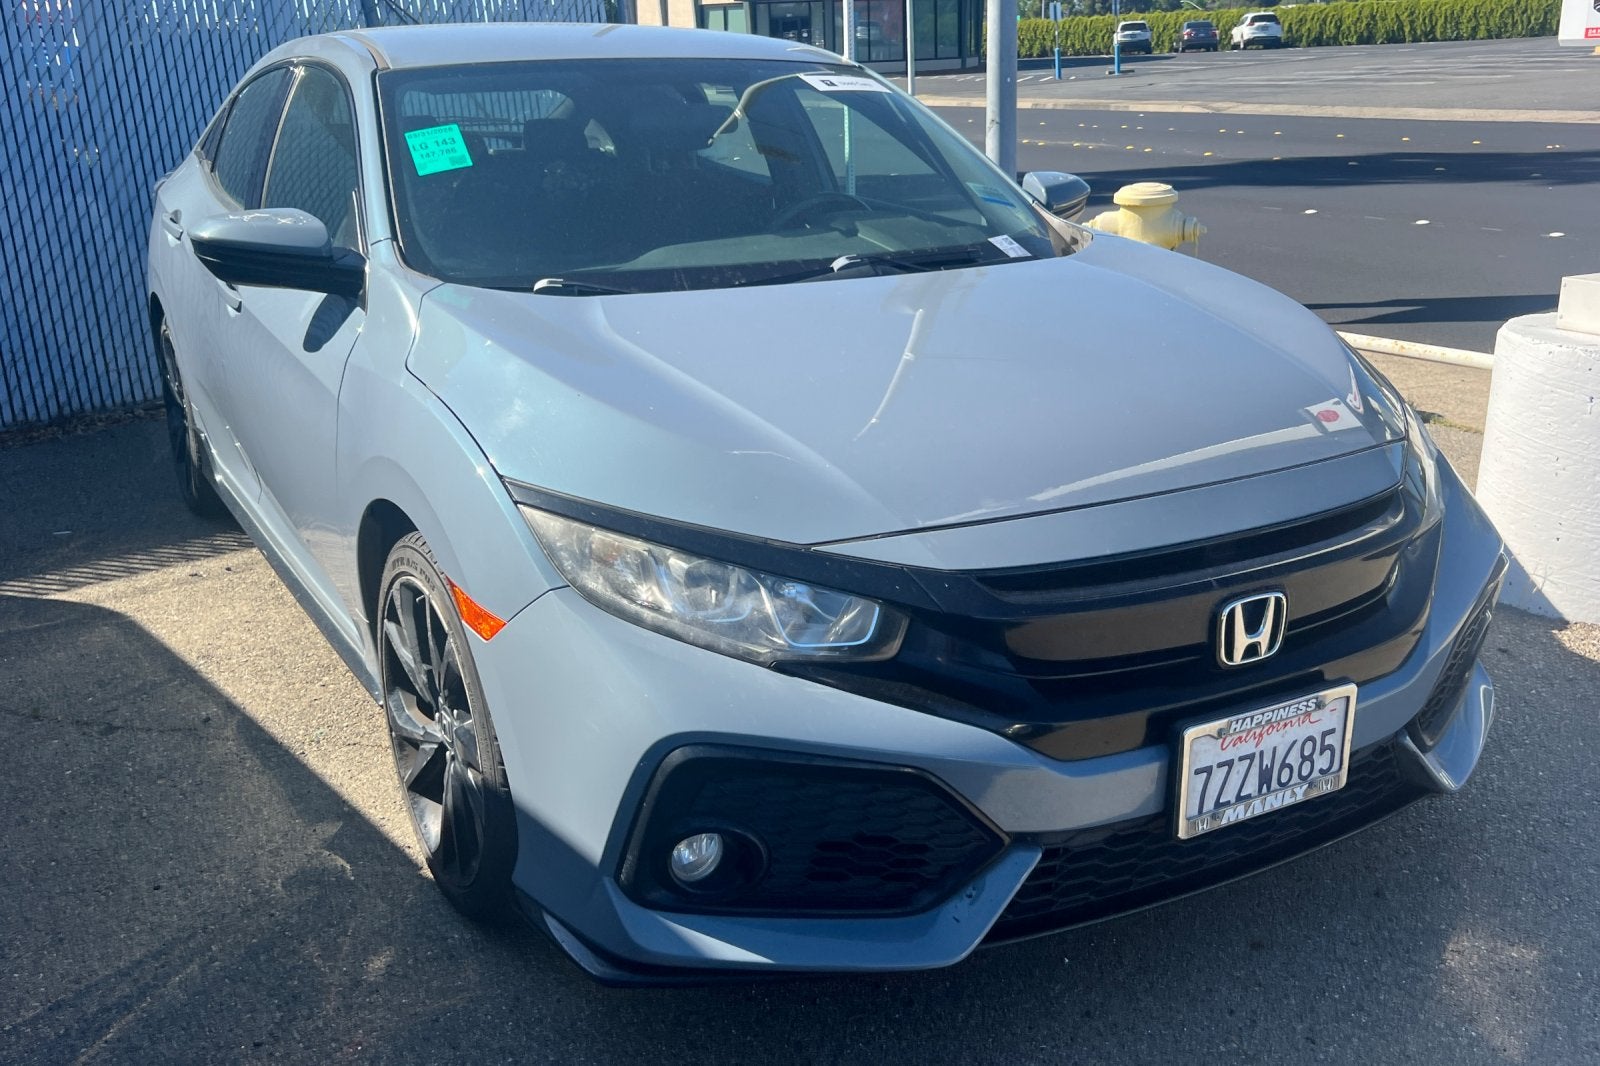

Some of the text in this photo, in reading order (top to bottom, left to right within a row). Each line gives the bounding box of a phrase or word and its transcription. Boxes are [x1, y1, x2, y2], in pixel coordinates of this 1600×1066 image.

[411, 137, 456, 152] LG 143
[1220, 711, 1322, 752] California
[1229, 698, 1318, 734] HAPPINESS
[1193, 727, 1337, 816] 7ZZW685
[1220, 783, 1310, 825] MANLY
